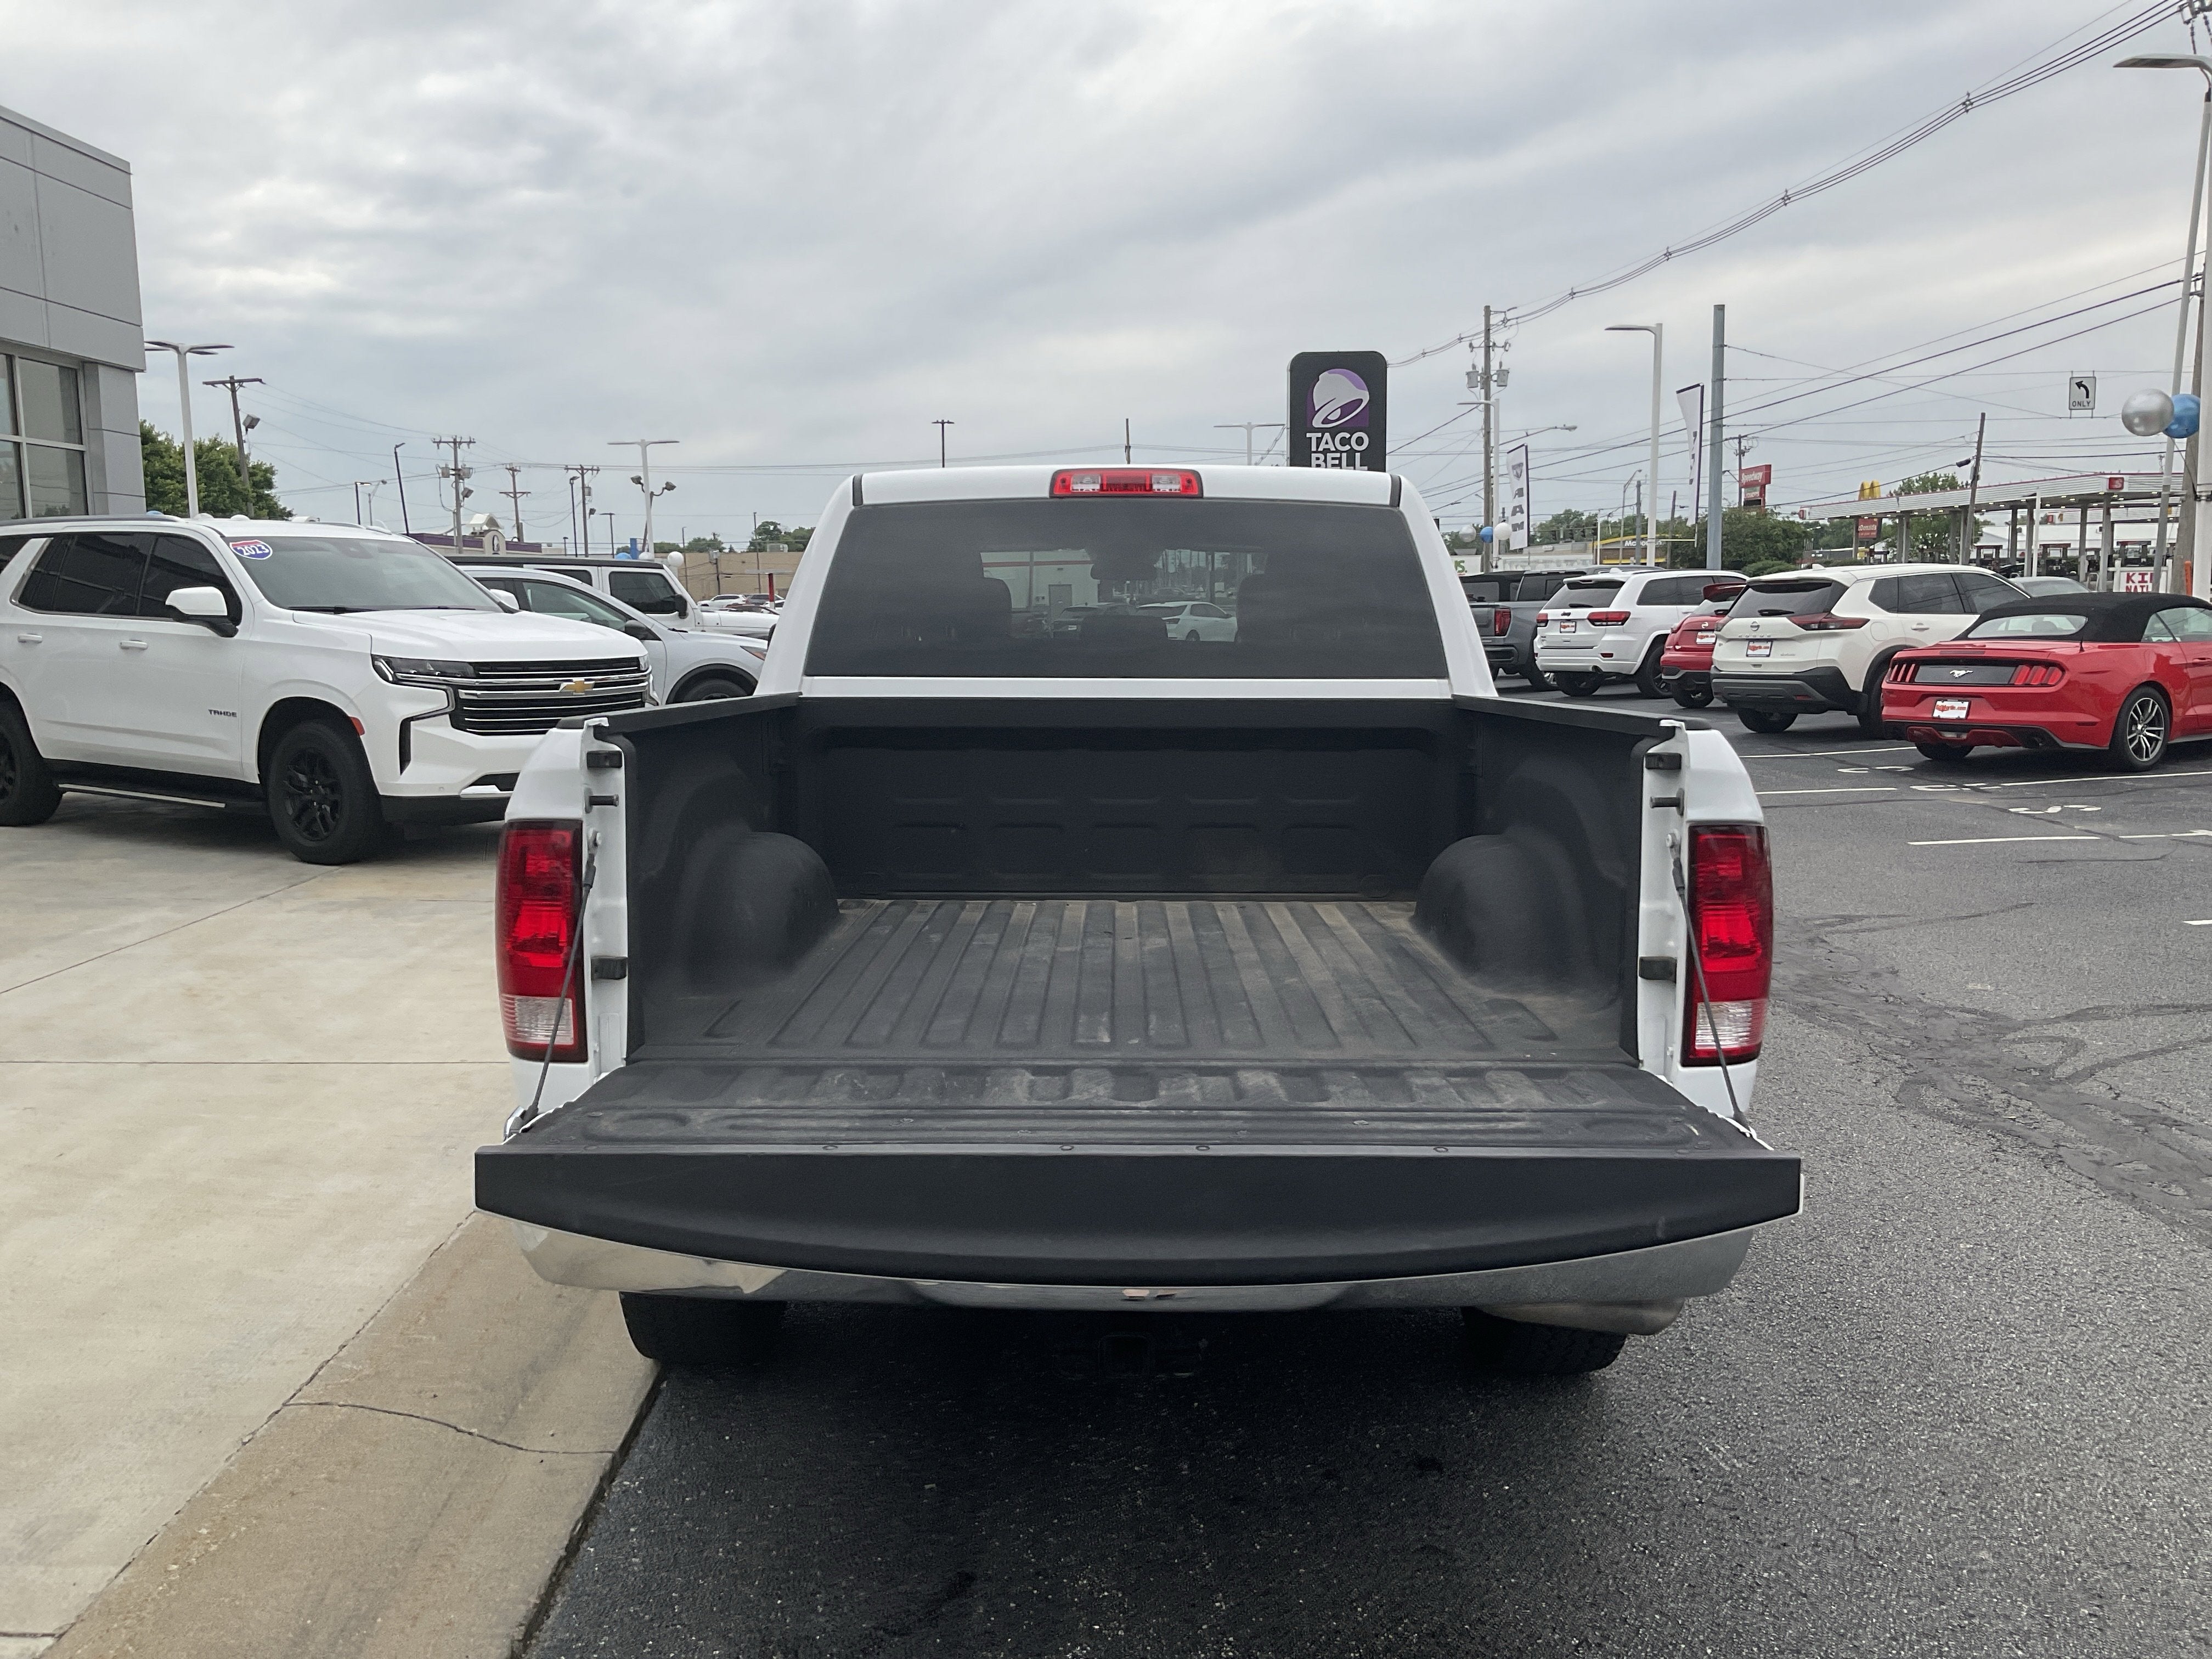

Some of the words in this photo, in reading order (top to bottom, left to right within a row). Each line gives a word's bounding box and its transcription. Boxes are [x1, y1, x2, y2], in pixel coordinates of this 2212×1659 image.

[1306, 432, 1369, 452] TACO
[1311, 453, 1368, 471] BELL
[237, 544, 270, 555] 2023
[208, 709, 237, 718] TAHOE
